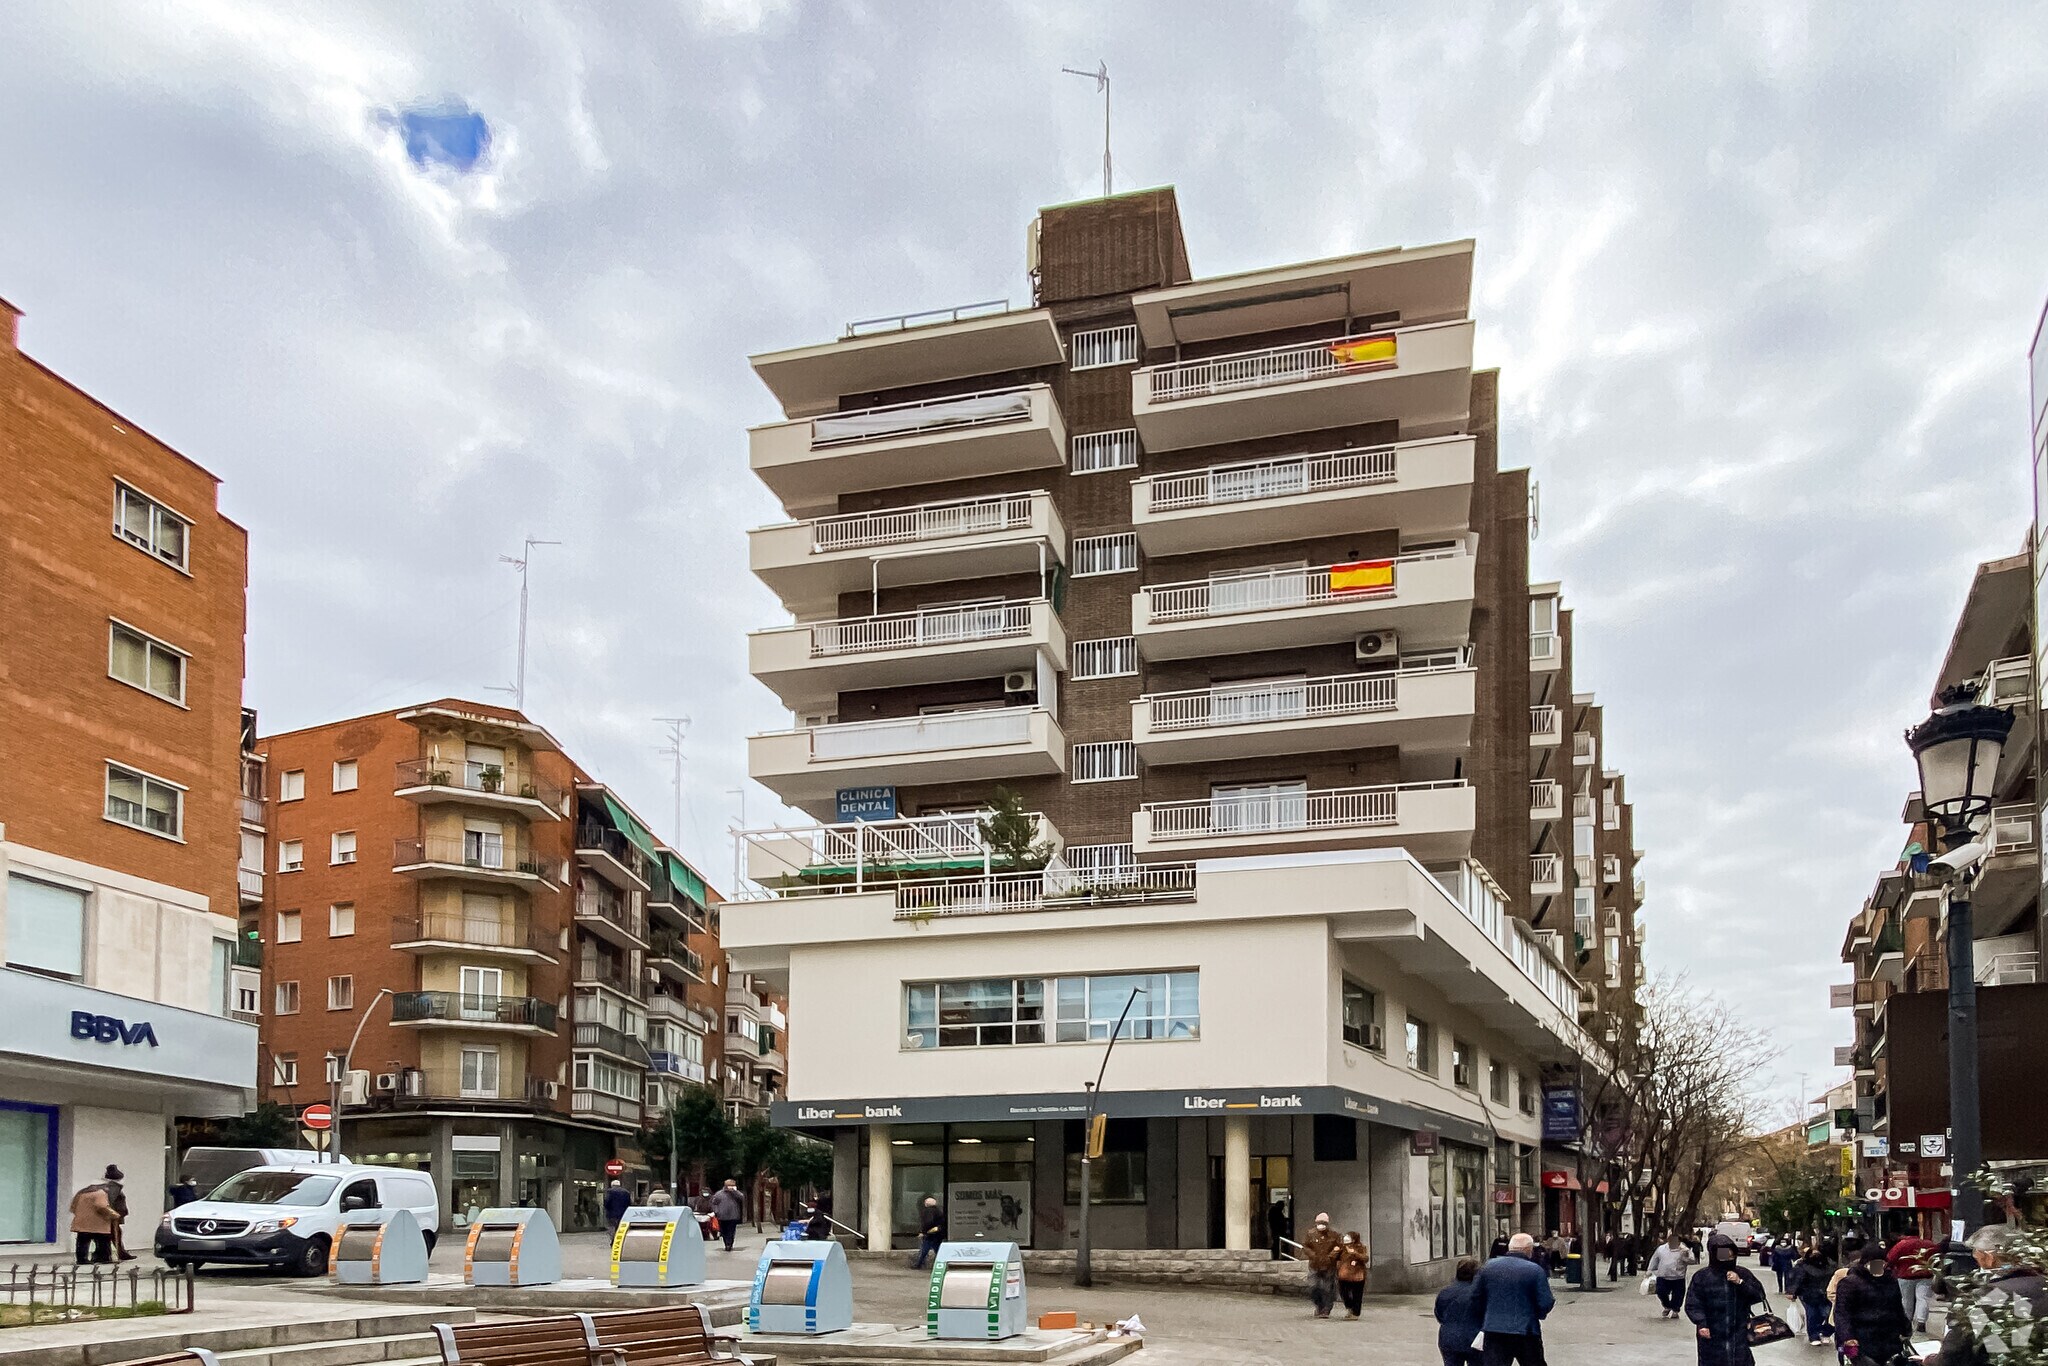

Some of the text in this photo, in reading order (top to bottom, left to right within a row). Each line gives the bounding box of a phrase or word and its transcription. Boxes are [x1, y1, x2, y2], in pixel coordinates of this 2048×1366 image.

[840, 788, 891, 801] CLINICA
[841, 800, 890, 813] DENTAL
[71, 1010, 159, 1047] BBVA
[1184, 1094, 1302, 1109] Liber bank
[798, 1105, 902, 1119] Liber bank
[929, 1262, 944, 1307] VIDRIO
[990, 1262, 1004, 1308] VIDRIO
